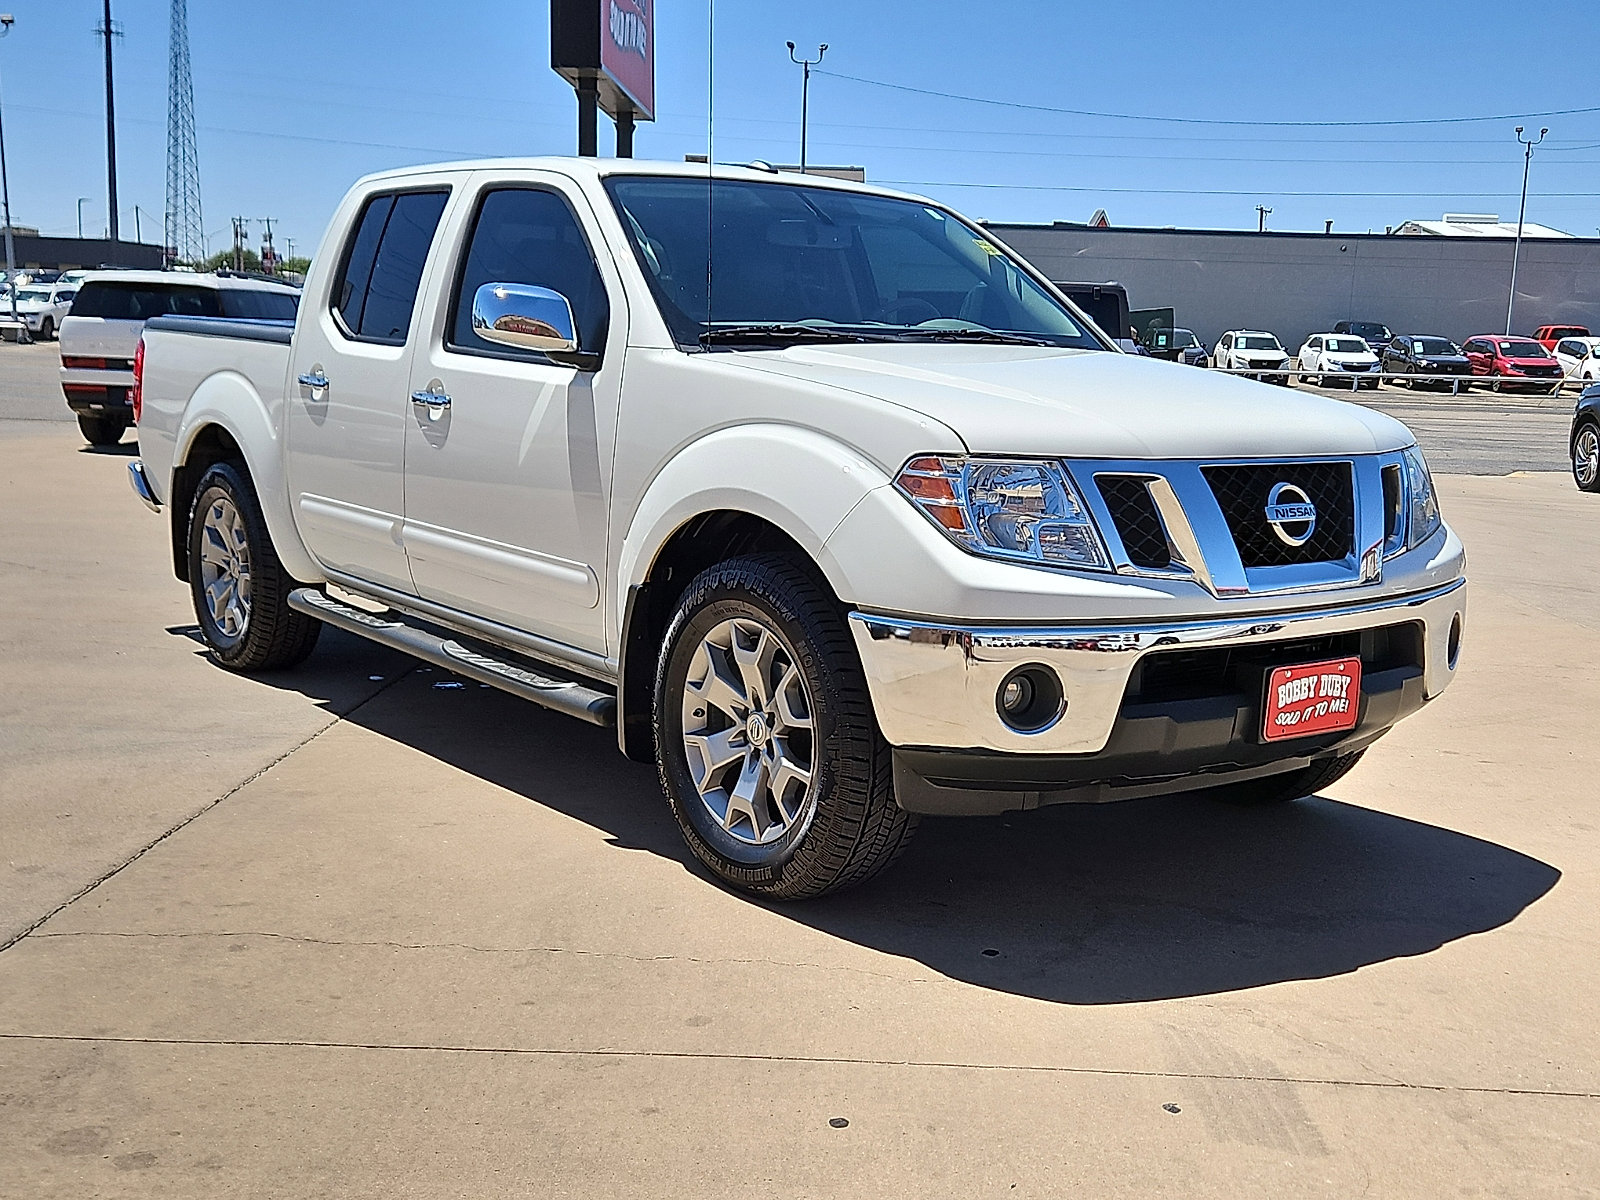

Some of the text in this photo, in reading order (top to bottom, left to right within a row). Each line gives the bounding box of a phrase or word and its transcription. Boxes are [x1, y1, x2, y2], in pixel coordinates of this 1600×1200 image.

[1274, 507, 1316, 518] NISSAN
[1277, 674, 1351, 708] BOBBY DUBY
[1274, 698, 1349, 725] SOLD IT TO ME!
